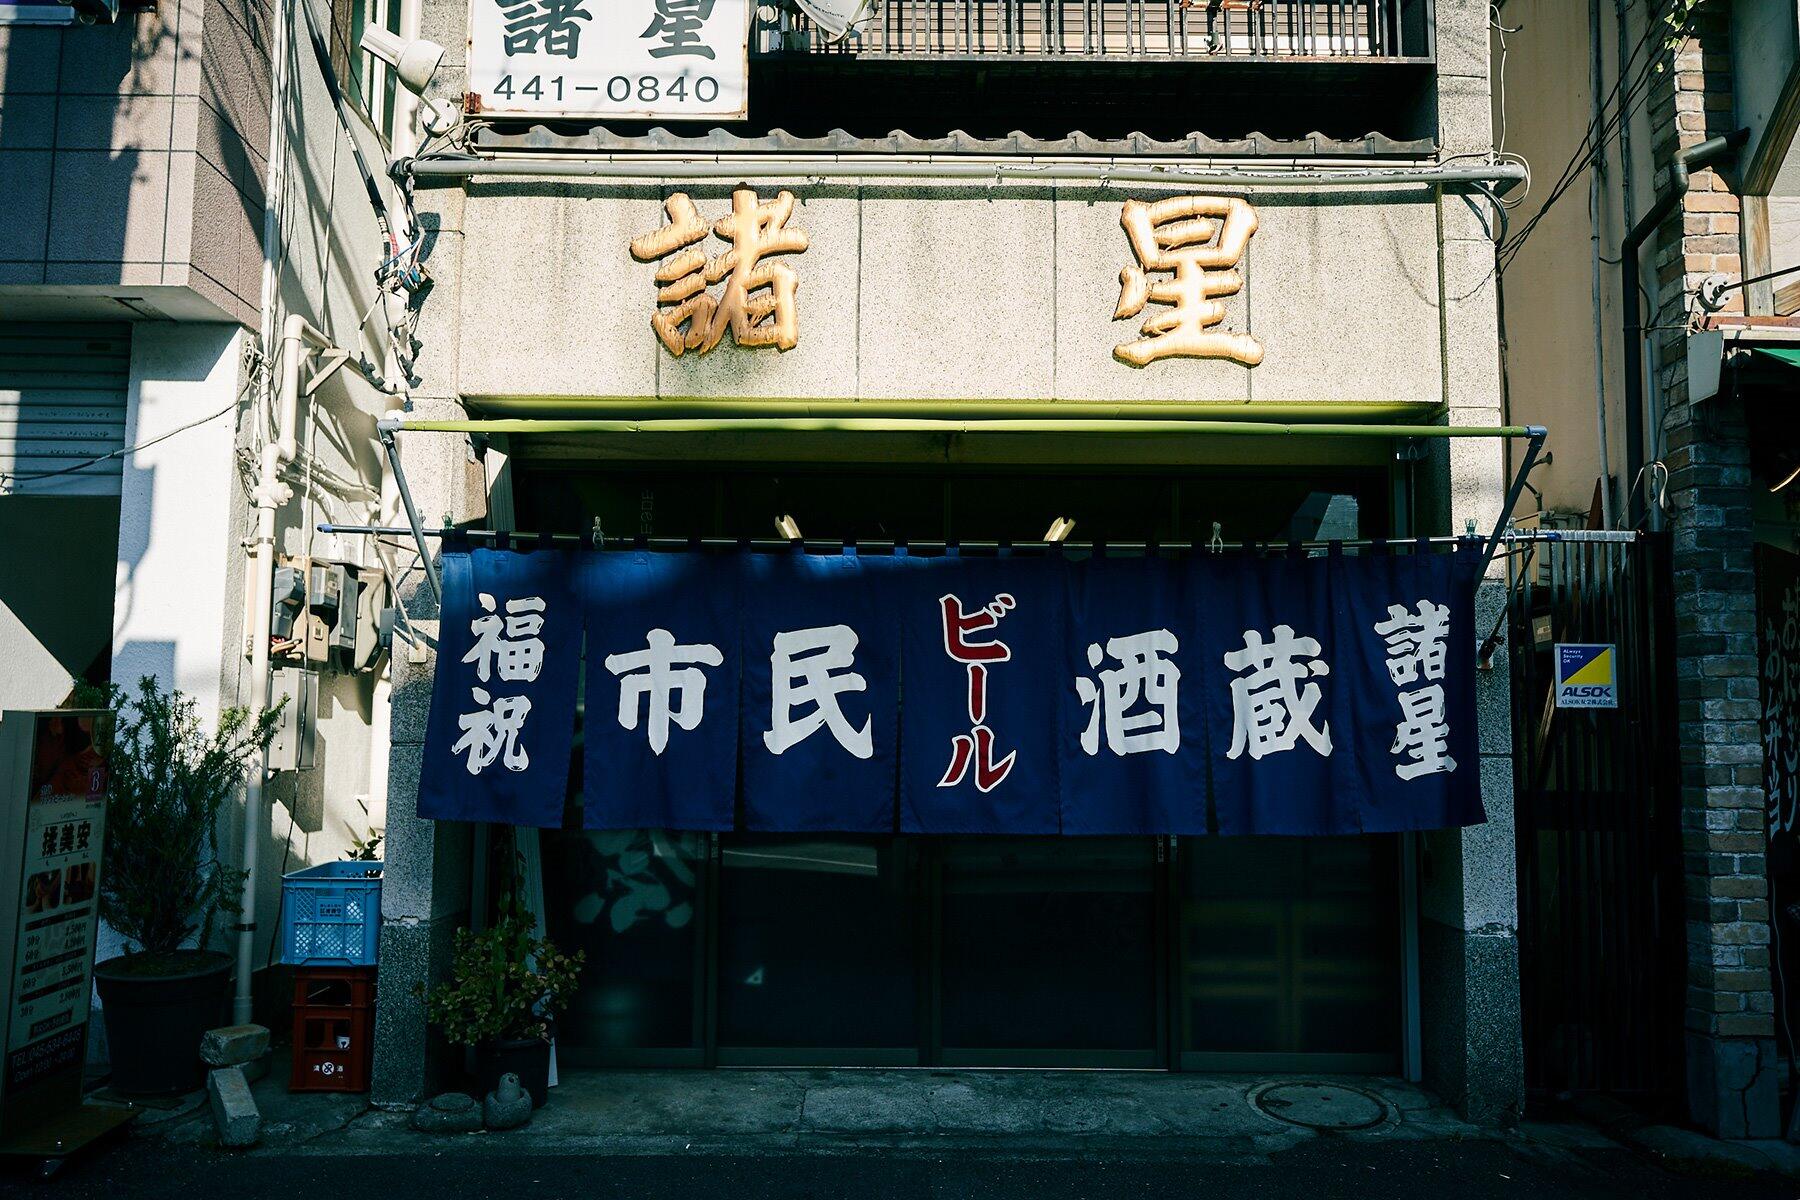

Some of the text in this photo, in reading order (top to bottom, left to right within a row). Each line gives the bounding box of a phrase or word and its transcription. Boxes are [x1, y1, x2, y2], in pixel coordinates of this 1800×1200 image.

[493, 74, 720, 103] 441-0840
[451, 592, 546, 775] 福祝
[605, 624, 873, 759] 市民
[936, 592, 1016, 792] ビール
[1075, 625, 1333, 760] 酒蔵
[1374, 599, 1458, 781] 諸星
[1561, 687, 1611, 697] ALSOK
